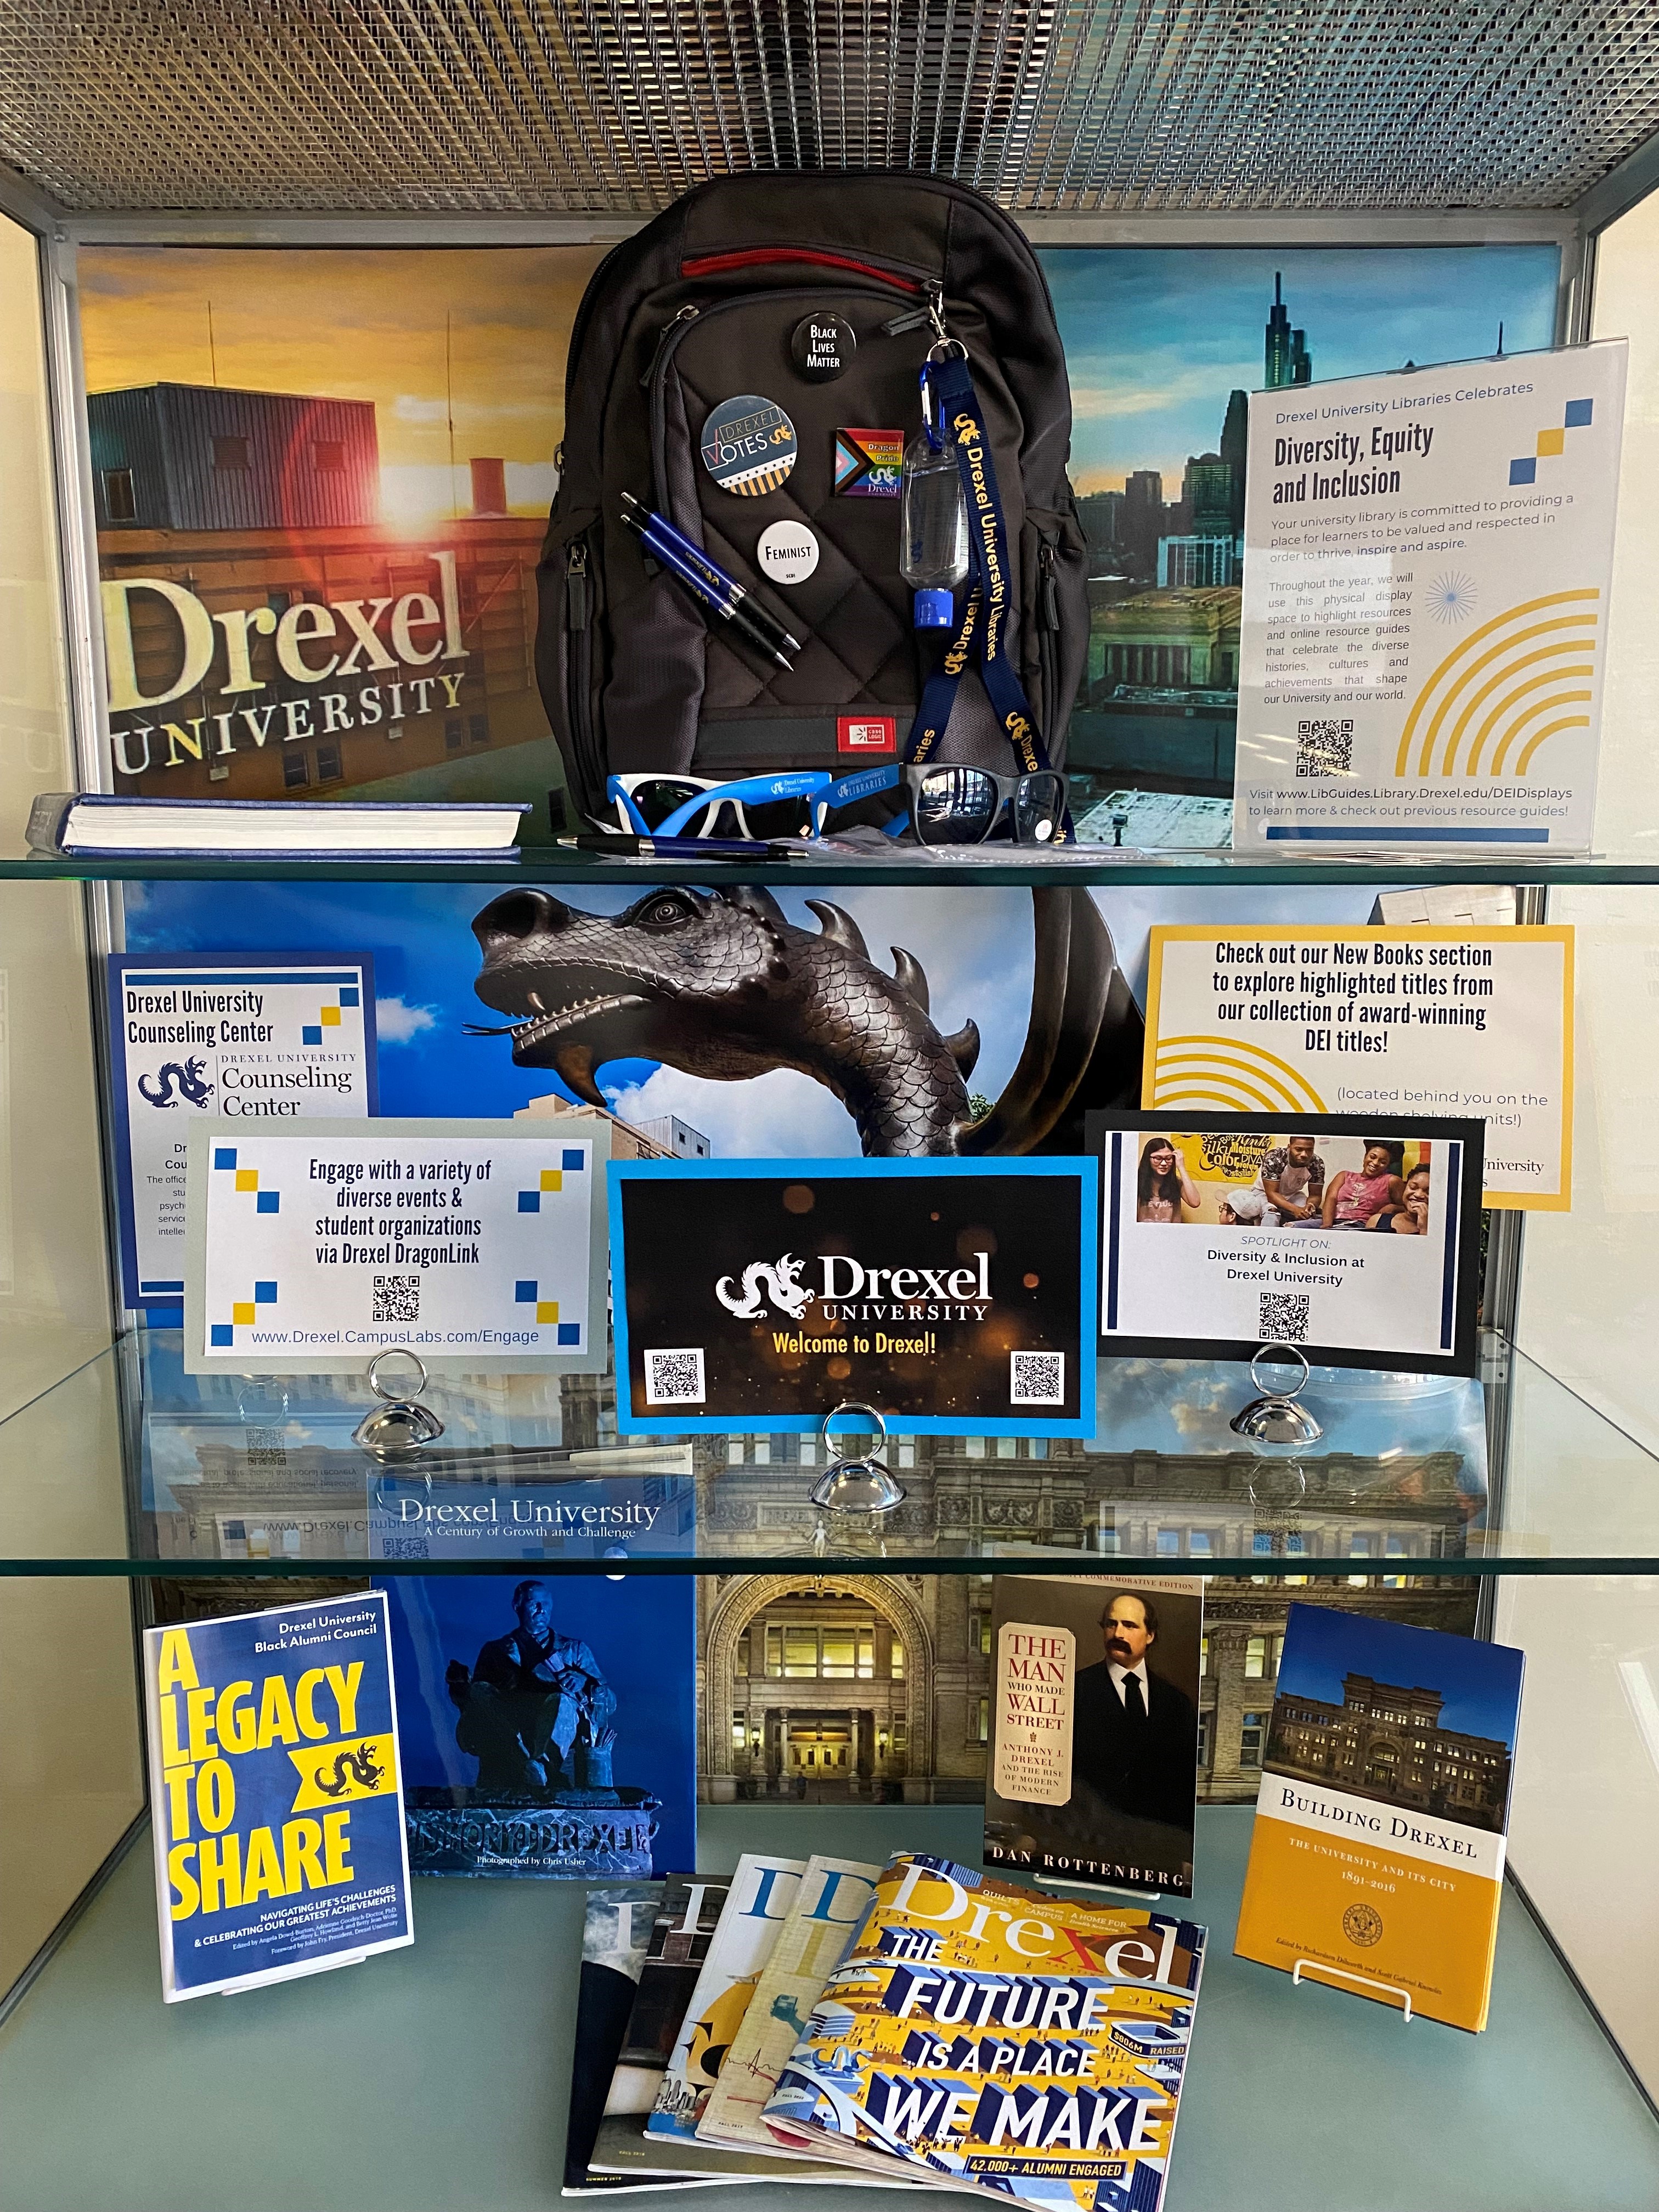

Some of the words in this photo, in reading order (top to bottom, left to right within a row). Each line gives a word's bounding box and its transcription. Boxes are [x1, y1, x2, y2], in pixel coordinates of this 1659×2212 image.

[810, 325, 837, 338] BLACK
[812, 340, 834, 353] LIVES
[807, 354, 840, 368] MATTER
[1276, 410, 1317, 424] Drexel
[1322, 401, 1388, 420] University
[1392, 393, 1451, 410] Libraries
[1455, 383, 1533, 402] Celebrates
[725, 411, 776, 439] DREXEL
[1276, 432, 1364, 466] Diversity,
[1372, 423, 1434, 460] Equity
[868, 483, 897, 493] Drexel
[968, 447, 993, 510] Drexel
[1273, 474, 1306, 504] and
[1313, 466, 1400, 500] Inclusion
[1272, 518, 1297, 531] Your
[1301, 514, 1356, 529] university
[1359, 510, 1395, 524] library
[1398, 509, 1407, 519] is
[1411, 501, 1480, 517] committed
[1484, 500, 1496, 512] to
[1500, 494, 1562, 512] providing
[1566, 493, 1573, 503] a
[1271, 535, 1300, 548] place
[1304, 532, 1318, 544] for
[1322, 528, 1368, 542] learners
[1372, 527, 1383, 539] to
[1387, 524, 1402, 537] be
[1405, 521, 1444, 535] valued
[1448, 518, 1472, 532] and
[1476, 513, 1539, 530] respected
[1544, 512, 1555, 524] in
[765, 546, 811, 560] FEMINIST
[981, 514, 1005, 603] University
[100, 550, 470, 713] Drexel
[952, 602, 979, 650] Drexel
[988, 604, 1005, 662] Libraries
[111, 673, 465, 775] UNIVERSITY
[849, 776, 887, 796] LIBRARIES
[1250, 788, 1273, 799] Visit
[1276, 787, 1572, 800] www.LibGuides.Library.Drexel.edu/DEIDisplays
[1216, 942, 1265, 964] Check
[1269, 945, 1296, 964] out
[1301, 949, 1328, 965] our
[1333, 944, 1368, 965] New
[1374, 943, 1424, 966] Books
[1429, 944, 1492, 966] section
[1212, 974, 1229, 992] to
[1234, 972, 1295, 997] explore
[1300, 973, 1396, 999] highlighted
[1401, 974, 1448, 995] titles
[1453, 974, 1493, 996] from
[127, 991, 176, 1013] Drexel
[183, 990, 263, 1017] University
[1218, 1003, 1245, 1021] our
[1250, 1000, 1332, 1023] collection
[1337, 1001, 1355, 1023] of
[1359, 1002, 1487, 1031] award-winning
[128, 1021, 216, 1048] Counseling
[221, 1020, 274, 1042] Center
[1305, 1029, 1331, 1052] DEI
[1336, 1030, 1389, 1054] titles!
[277, 1053, 356, 1063] UNIVERSITY
[222, 1066, 352, 1093] Counseling
[223, 1096, 301, 1116] Center
[1338, 1087, 1399, 1101] (located
[1404, 1089, 1459, 1103] behind
[1463, 1095, 1492, 1107] you
[1497, 1096, 1516, 1105] on
[1521, 1094, 1548, 1106] the
[310, 1160, 364, 1185] Engage
[368, 1160, 402, 1180] with
[406, 1164, 414, 1180] a
[419, 1160, 472, 1185] variety
[476, 1159, 492, 1180] of
[336, 1188, 392, 1207] diverse
[396, 1189, 447, 1207] events
[451, 1188, 462, 1207] &
[315, 1216, 374, 1235] student
[379, 1216, 482, 1240] organizations
[1240, 1235, 1307, 1249] SPOTLIGHT
[1310, 1238, 1331, 1249] ON:
[315, 1244, 337, 1264] via
[343, 1243, 390, 1264] Drexel
[395, 1243, 479, 1268] DragonLink
[1207, 1249, 1267, 1264] Diversity
[1271, 1252, 1281, 1263] &
[1284, 1252, 1348, 1268] Inclusion
[1351, 1256, 1364, 1268] at
[817, 1252, 994, 1301] Drexel
[1227, 1268, 1270, 1281] Drexel
[1274, 1270, 1343, 1287] University
[823, 1305, 989, 1322] UNIVERSITY
[251, 1329, 539, 1346] www.Drexel.CampusLabs.com/Engage
[772, 1332, 848, 1354] Welcome
[853, 1335, 870, 1354] to
[876, 1333, 936, 1355] Drexel!
[399, 1499, 497, 1523] Drexel
[511, 1499, 661, 1530] University
[424, 1526, 433, 1537] A
[437, 1526, 485, 1540] Century
[488, 1526, 500, 1537] of
[503, 1526, 549, 1540] Growth
[551, 1526, 573, 1537] and
[577, 1526, 636, 1540] Challenge
[279, 1618, 317, 1634] Drexel
[319, 1610, 376, 1628] University
[255, 1639, 287, 1654] Black
[290, 1631, 331, 1648] Alumni
[334, 1624, 377, 1641] Council
[1008, 1634, 1066, 1660] THE
[159, 1629, 200, 1695] A
[1008, 1658, 1065, 1684] MAN
[1008, 1681, 1032, 1692] WHO
[1035, 1684, 1065, 1696] MADE
[160, 1661, 364, 1768] LEGACY
[1006, 1693, 1065, 1716] WALL
[1007, 1714, 1064, 1731] STREET
[164, 1758, 236, 1841] TO
[1280, 1787, 1381, 1831] BUILDING
[1389, 1816, 1477, 1859] DREXEL
[168, 1810, 354, 1921] SHARE
[477, 1856, 528, 1866] Photographed
[531, 1857, 540, 1866] by
[993, 1847, 1031, 1863] DAN
[1044, 1854, 1183, 1887] ROTTENBERG
[1289, 1837, 1310, 1850] THE
[1313, 1845, 1379, 1869] UNIVERSITY
[1381, 1864, 1404, 1877] AND
[1408, 1871, 1426, 1883] ITS
[1429, 1877, 1457, 1892] CITY
[879, 1862, 1178, 1983] Drexel
[891, 1934, 948, 1962] THE
[898, 1977, 1115, 2030] FUTURE
[1114, 2032, 1143, 2053] $806M
[916, 2041, 952, 2067] IS
[957, 2046, 980, 2073] A
[990, 2046, 1099, 2078] PLACE
[884, 2086, 980, 2143] WE
[988, 2095, 1167, 2150] MAKE
[1022, 2162, 1066, 2176] ALUMNI
[1069, 2163, 1121, 2176] ENGAGED
